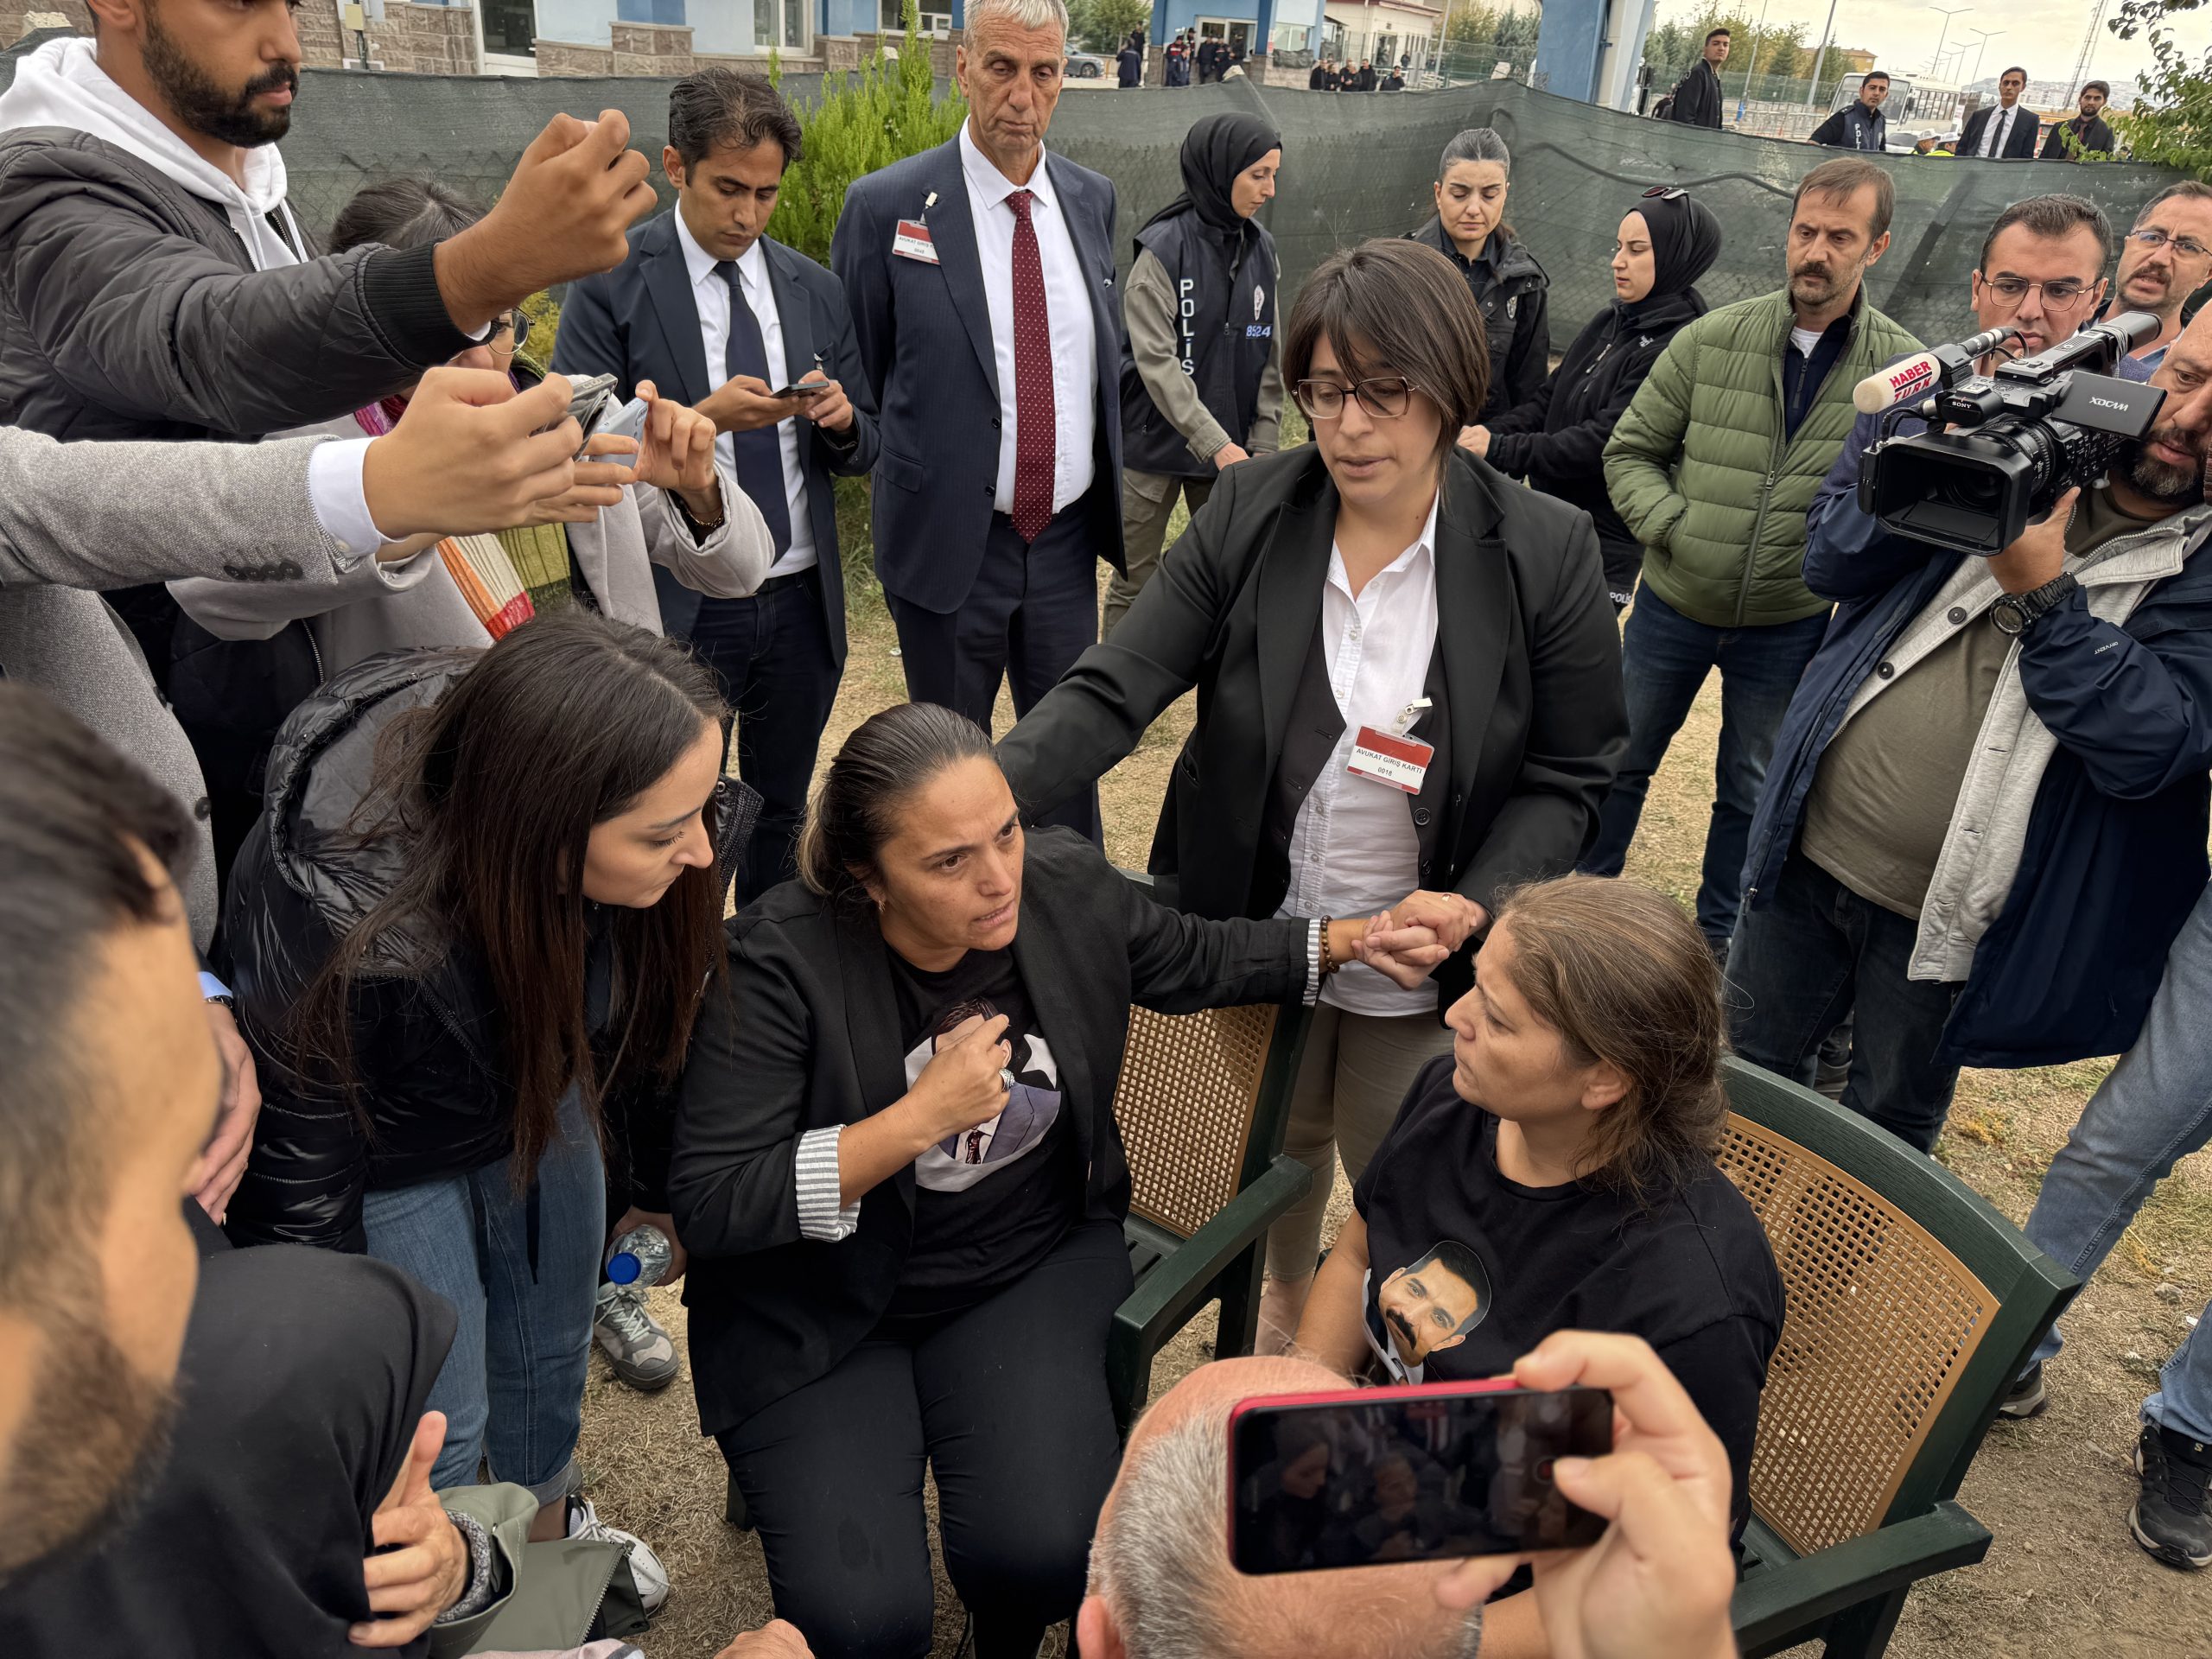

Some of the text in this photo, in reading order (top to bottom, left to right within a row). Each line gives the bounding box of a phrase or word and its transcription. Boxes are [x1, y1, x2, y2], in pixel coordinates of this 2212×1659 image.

[1179, 278, 1195, 376] POLİS
[1245, 324, 1272, 338] 8524
[1889, 360, 1932, 389] HABER
[2088, 397, 2129, 412] XDCAM
[2094, 641, 2119, 655] DRYVENT
[1356, 747, 1423, 774] AVUKAT GİRİŞ KARTI
[1377, 766, 1393, 776] 0018
